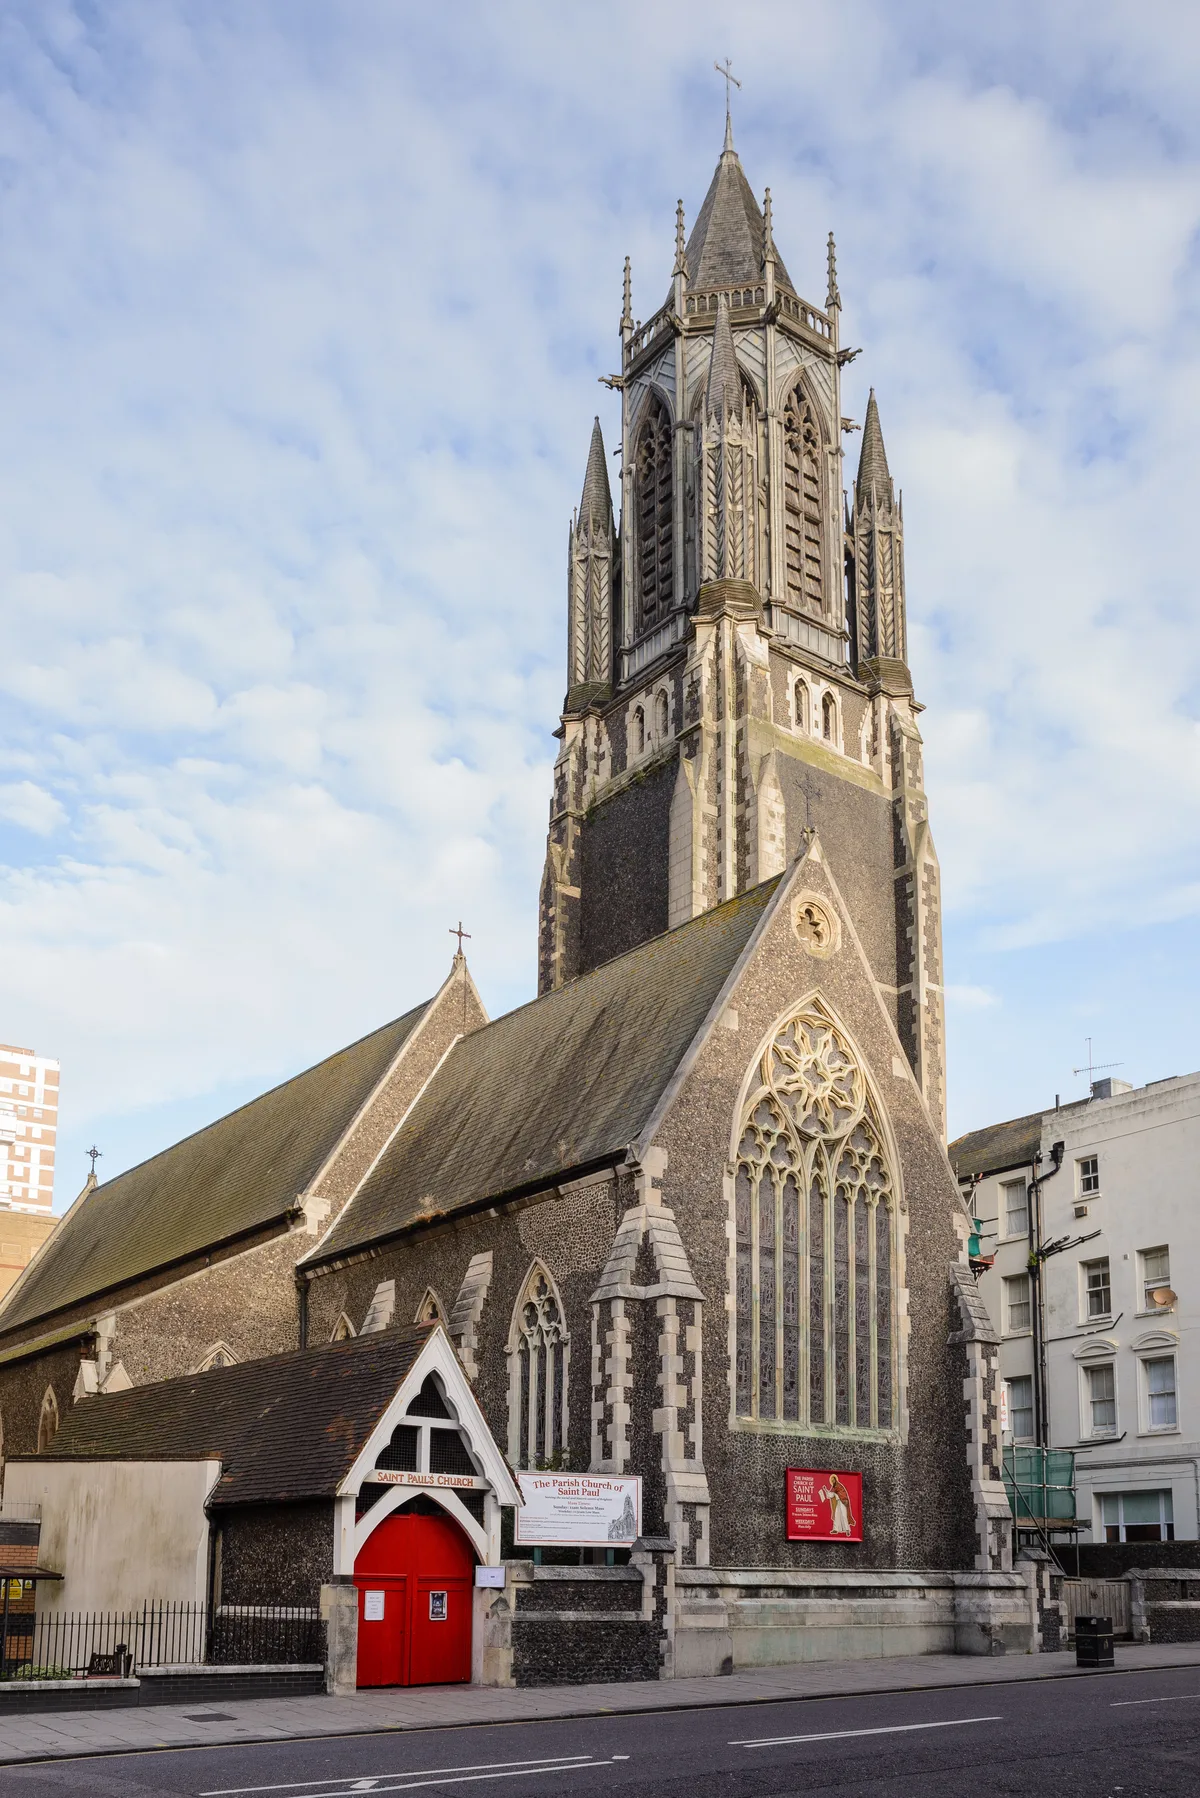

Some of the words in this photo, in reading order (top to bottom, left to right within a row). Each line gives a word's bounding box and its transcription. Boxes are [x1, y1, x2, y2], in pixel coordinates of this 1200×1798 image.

[377, 1471, 404, 1483] SAINT
[407, 1473, 435, 1485] PAUL'S
[437, 1475, 474, 1487] CHURCH
[533, 1479, 551, 1489] The
[552, 1478, 580, 1487] Parish
[581, 1479, 612, 1490] Church
[613, 1484, 624, 1493] of
[793, 1485, 814, 1494] SAINT
[557, 1487, 580, 1496] Saint
[581, 1488, 600, 1497] Paul
[795, 1494, 813, 1502] PAUL
